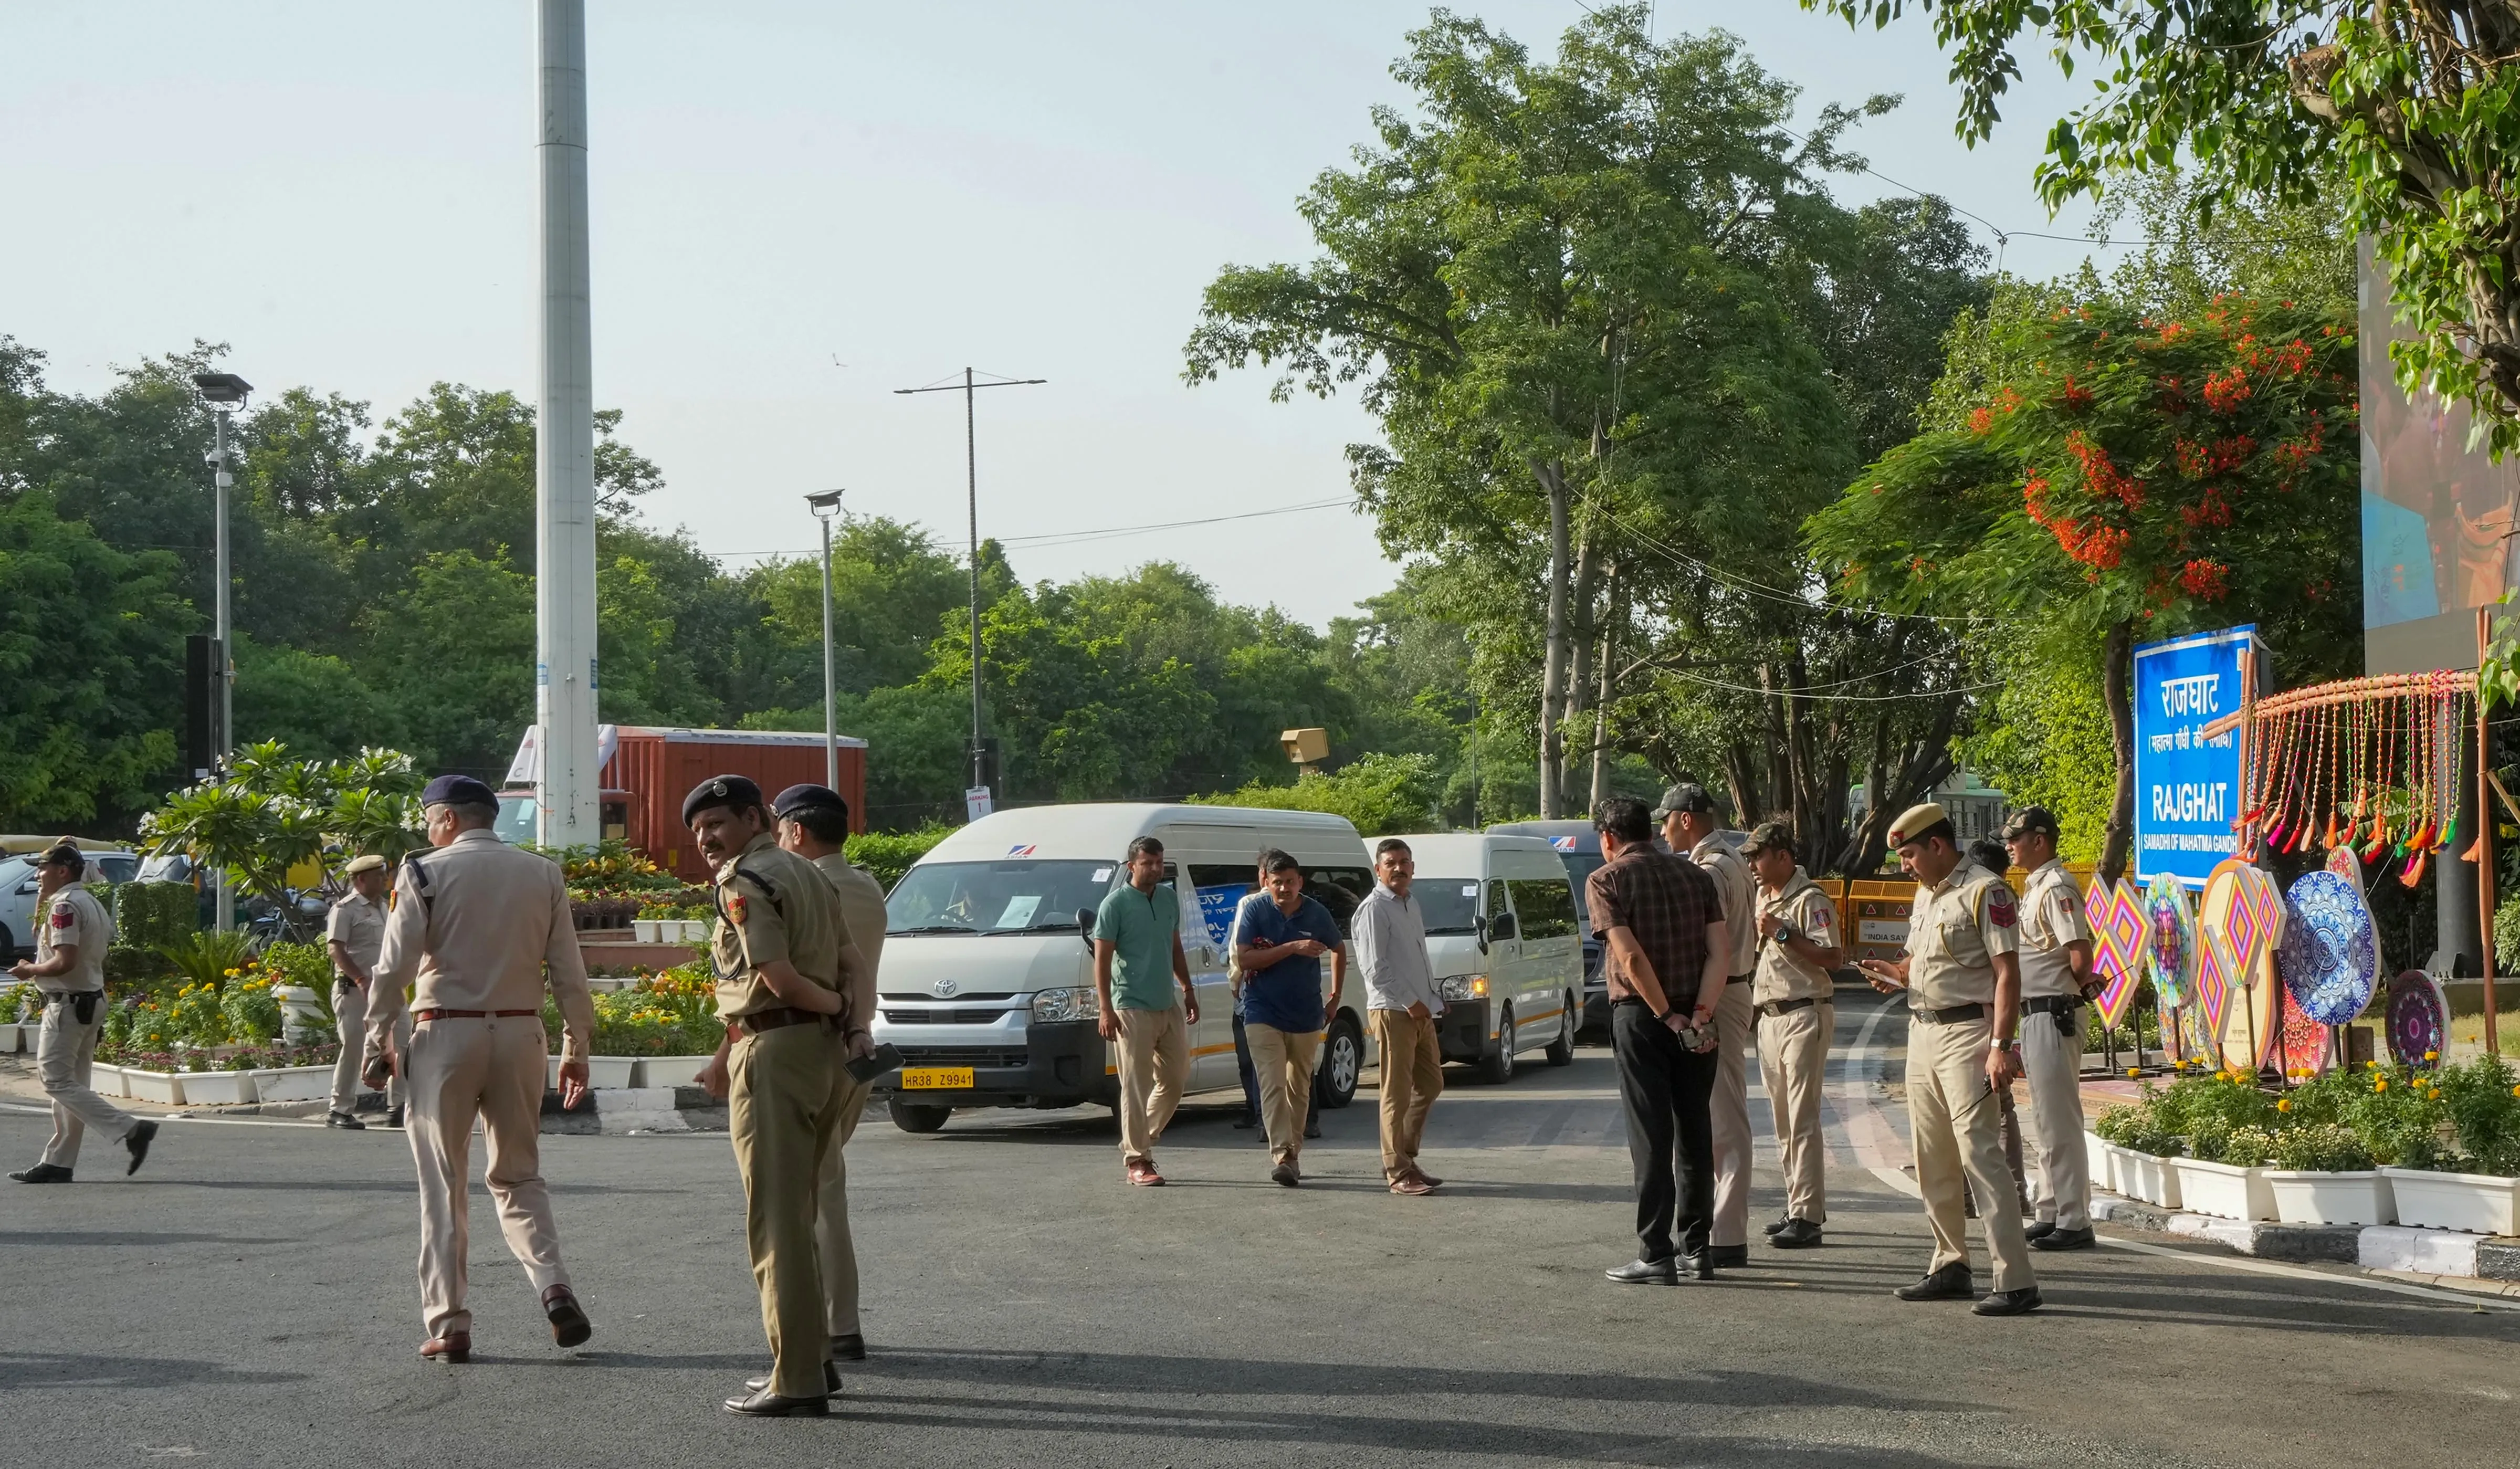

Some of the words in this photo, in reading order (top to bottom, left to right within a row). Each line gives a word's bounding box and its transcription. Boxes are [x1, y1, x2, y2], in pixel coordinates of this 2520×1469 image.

[2160, 673, 2219, 718] राजघाट
[2192, 723, 2203, 749] की
[2152, 782, 2227, 822] RAJGHAT
[2171, 834, 2178, 851] OF
[2179, 834, 2212, 852] MAHATMA
[2213, 835, 2238, 853] GANDH
[906, 1075, 931, 1087] HR38
[940, 1074, 971, 1086] Z9941
